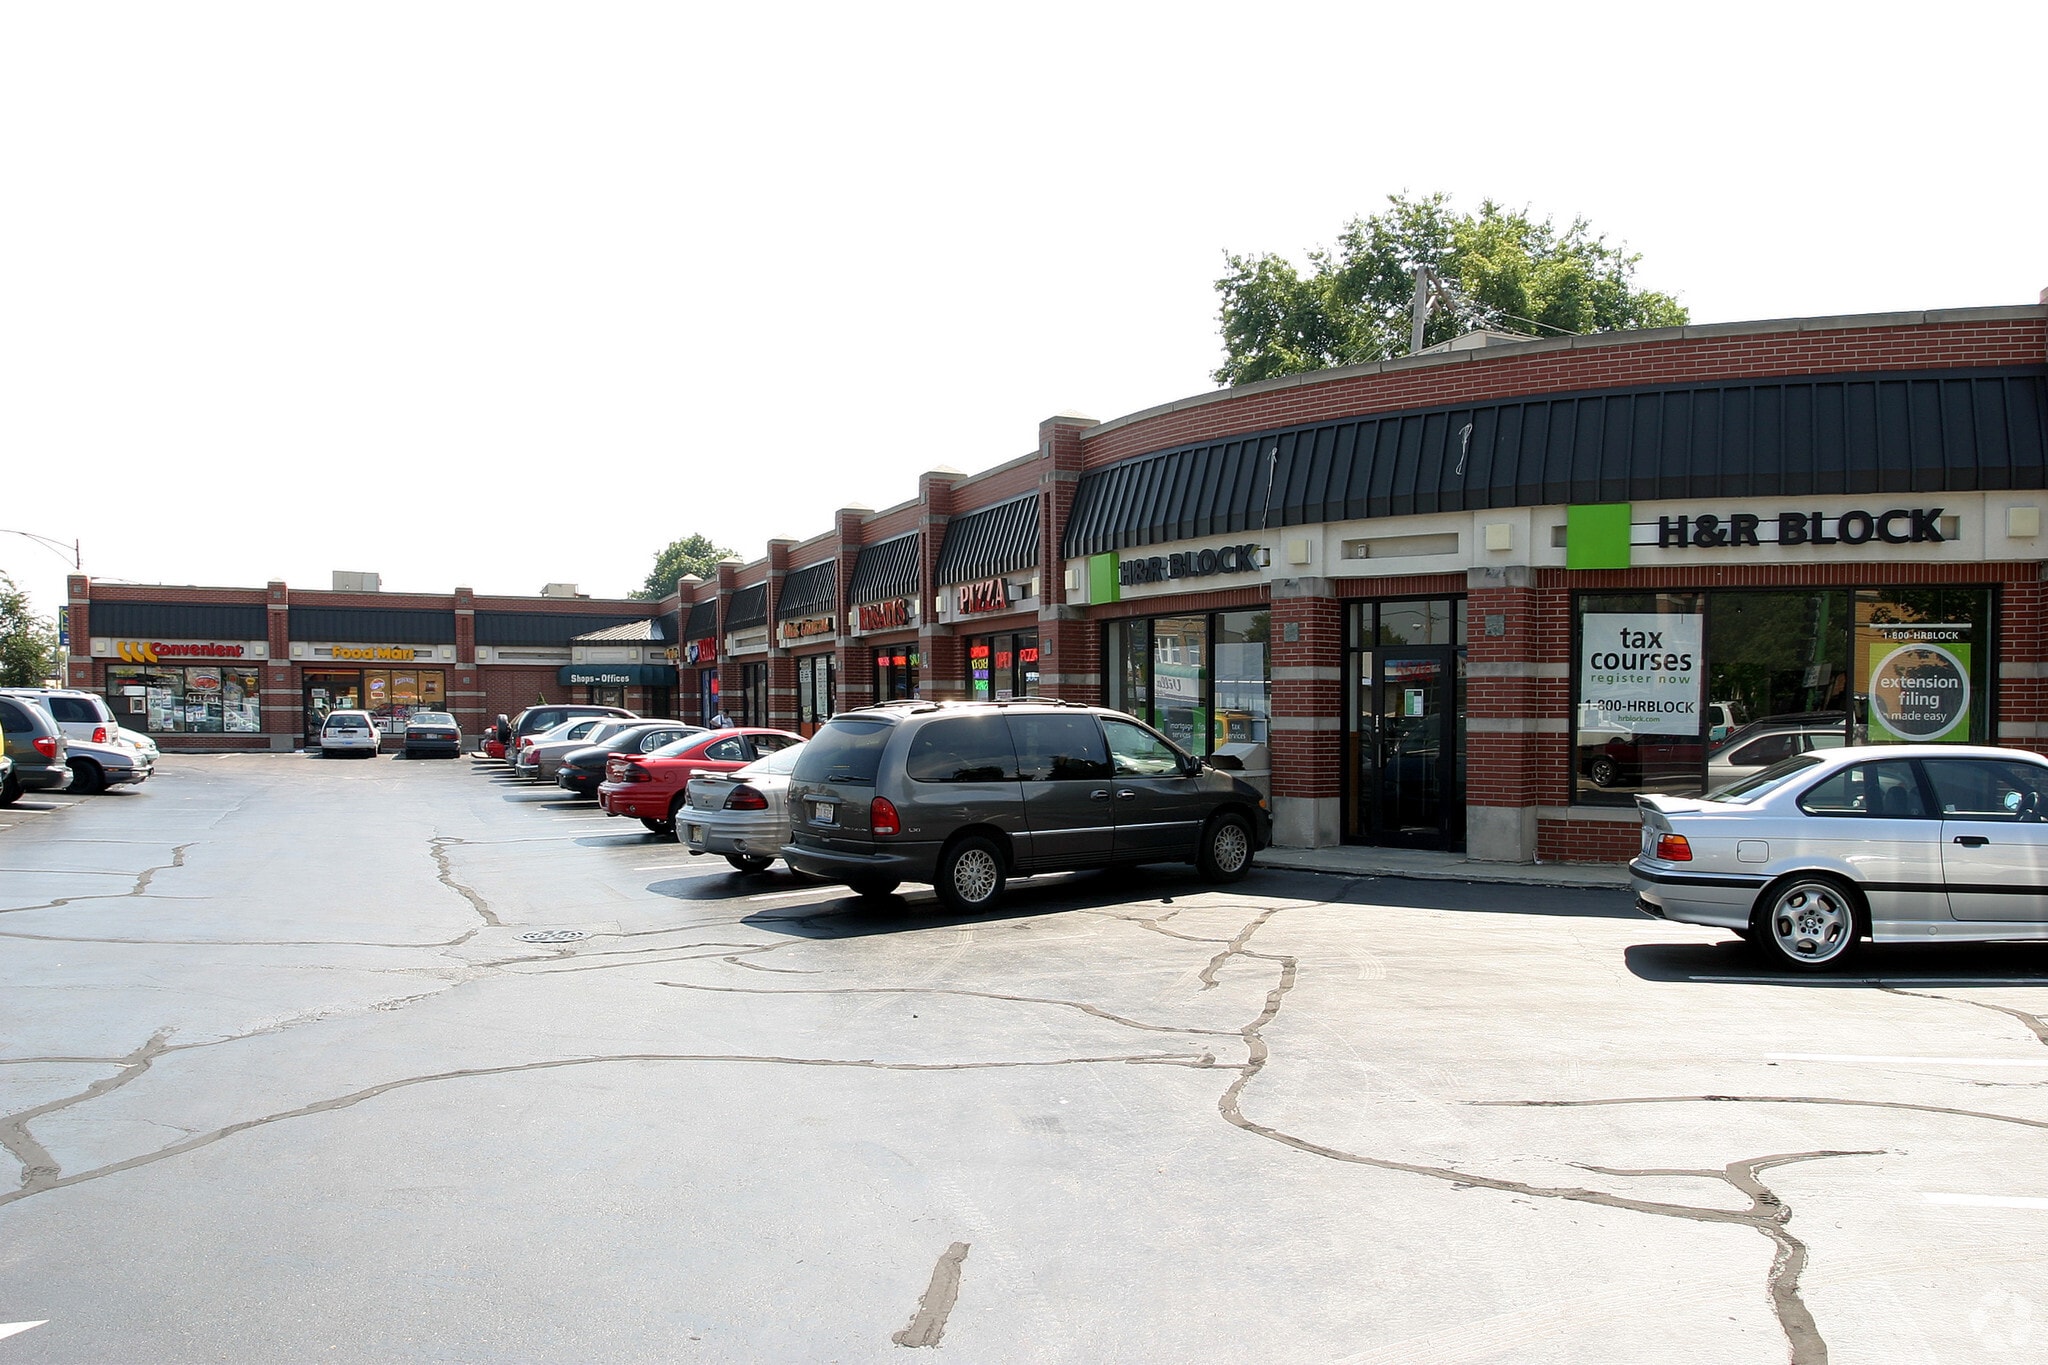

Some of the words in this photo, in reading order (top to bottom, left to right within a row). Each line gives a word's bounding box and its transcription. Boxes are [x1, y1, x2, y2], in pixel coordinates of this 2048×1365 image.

[1658, 514, 1760, 548] H&R
[1778, 508, 1945, 545] BLOCK
[1120, 556, 1168, 587] H&R
[1169, 543, 1260, 579] BLOCK
[960, 578, 1007, 614] PIZZA
[1620, 627, 1663, 649] tax
[1883, 631, 1960, 640] 1-800-HRBLOCK
[151, 642, 242, 657] Convenient
[332, 645, 374, 660] Food
[377, 646, 415, 661] Mart
[1590, 652, 1692, 671] courses
[571, 674, 595, 685] Shops
[601, 673, 630, 683] Offices
[1591, 673, 1652, 684] register
[1658, 676, 1691, 684] now
[1880, 675, 1959, 688] extension
[1585, 699, 1695, 713] 1-800-HRBLOCK
[1899, 691, 1940, 709] filing
[1891, 711, 1922, 720] made
[1923, 713, 1947, 723] easy
